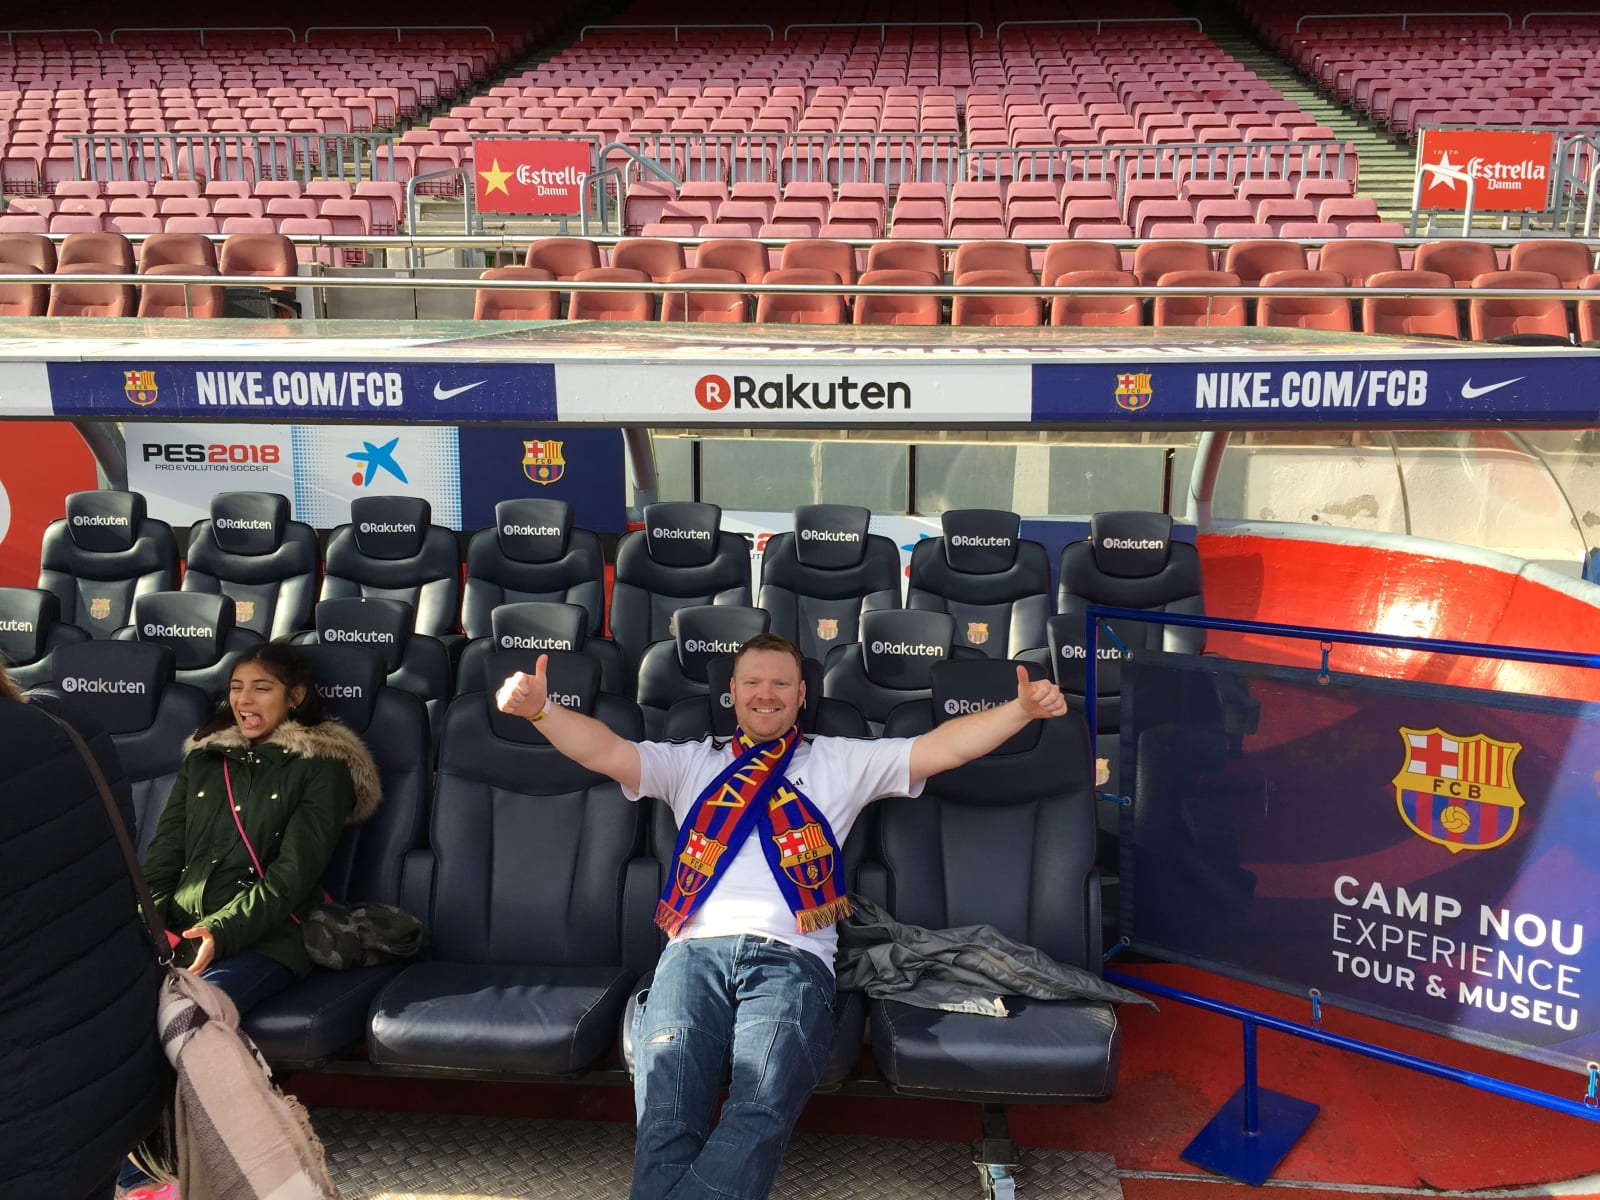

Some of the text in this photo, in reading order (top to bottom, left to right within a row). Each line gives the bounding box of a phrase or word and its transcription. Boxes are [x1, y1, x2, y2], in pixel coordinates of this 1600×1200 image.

[516, 163, 587, 186] Estrella
[1466, 156, 1546, 180] Estrella
[537, 185, 568, 196] Damm
[1487, 178, 1522, 190] Damm
[195, 371, 404, 407] NIKE.COM/FCB
[734, 373, 911, 411] Rakuten
[1195, 369, 1428, 409] NIKE.COM/FCB
[155, 463, 269, 472] PRO EVOLUTION SOCCER
[84, 515, 128, 527] Rakuten
[226, 518, 272, 530] Rakuten
[370, 522, 416, 533] Rakuten
[514, 524, 561, 536] Rakuten
[663, 528, 711, 540] Rakuten
[811, 529, 860, 542] Rakuten
[962, 535, 1011, 547] Rakuten
[1113, 538, 1164, 550] Rakuten
[156, 624, 213, 638] Rakuten
[337, 629, 394, 644] Rakuten
[514, 636, 571, 651] Rakuten
[698, 640, 743, 653] Rakut
[884, 641, 943, 657] Rakuten
[78, 677, 145, 694] Rakuten
[314, 683, 362, 699] kuten
[1334, 875, 1584, 956] CAMP NOU
[1332, 912, 1582, 999] EXPERIENCE
[1332, 950, 1579, 1031] TOUR & MUSEU
